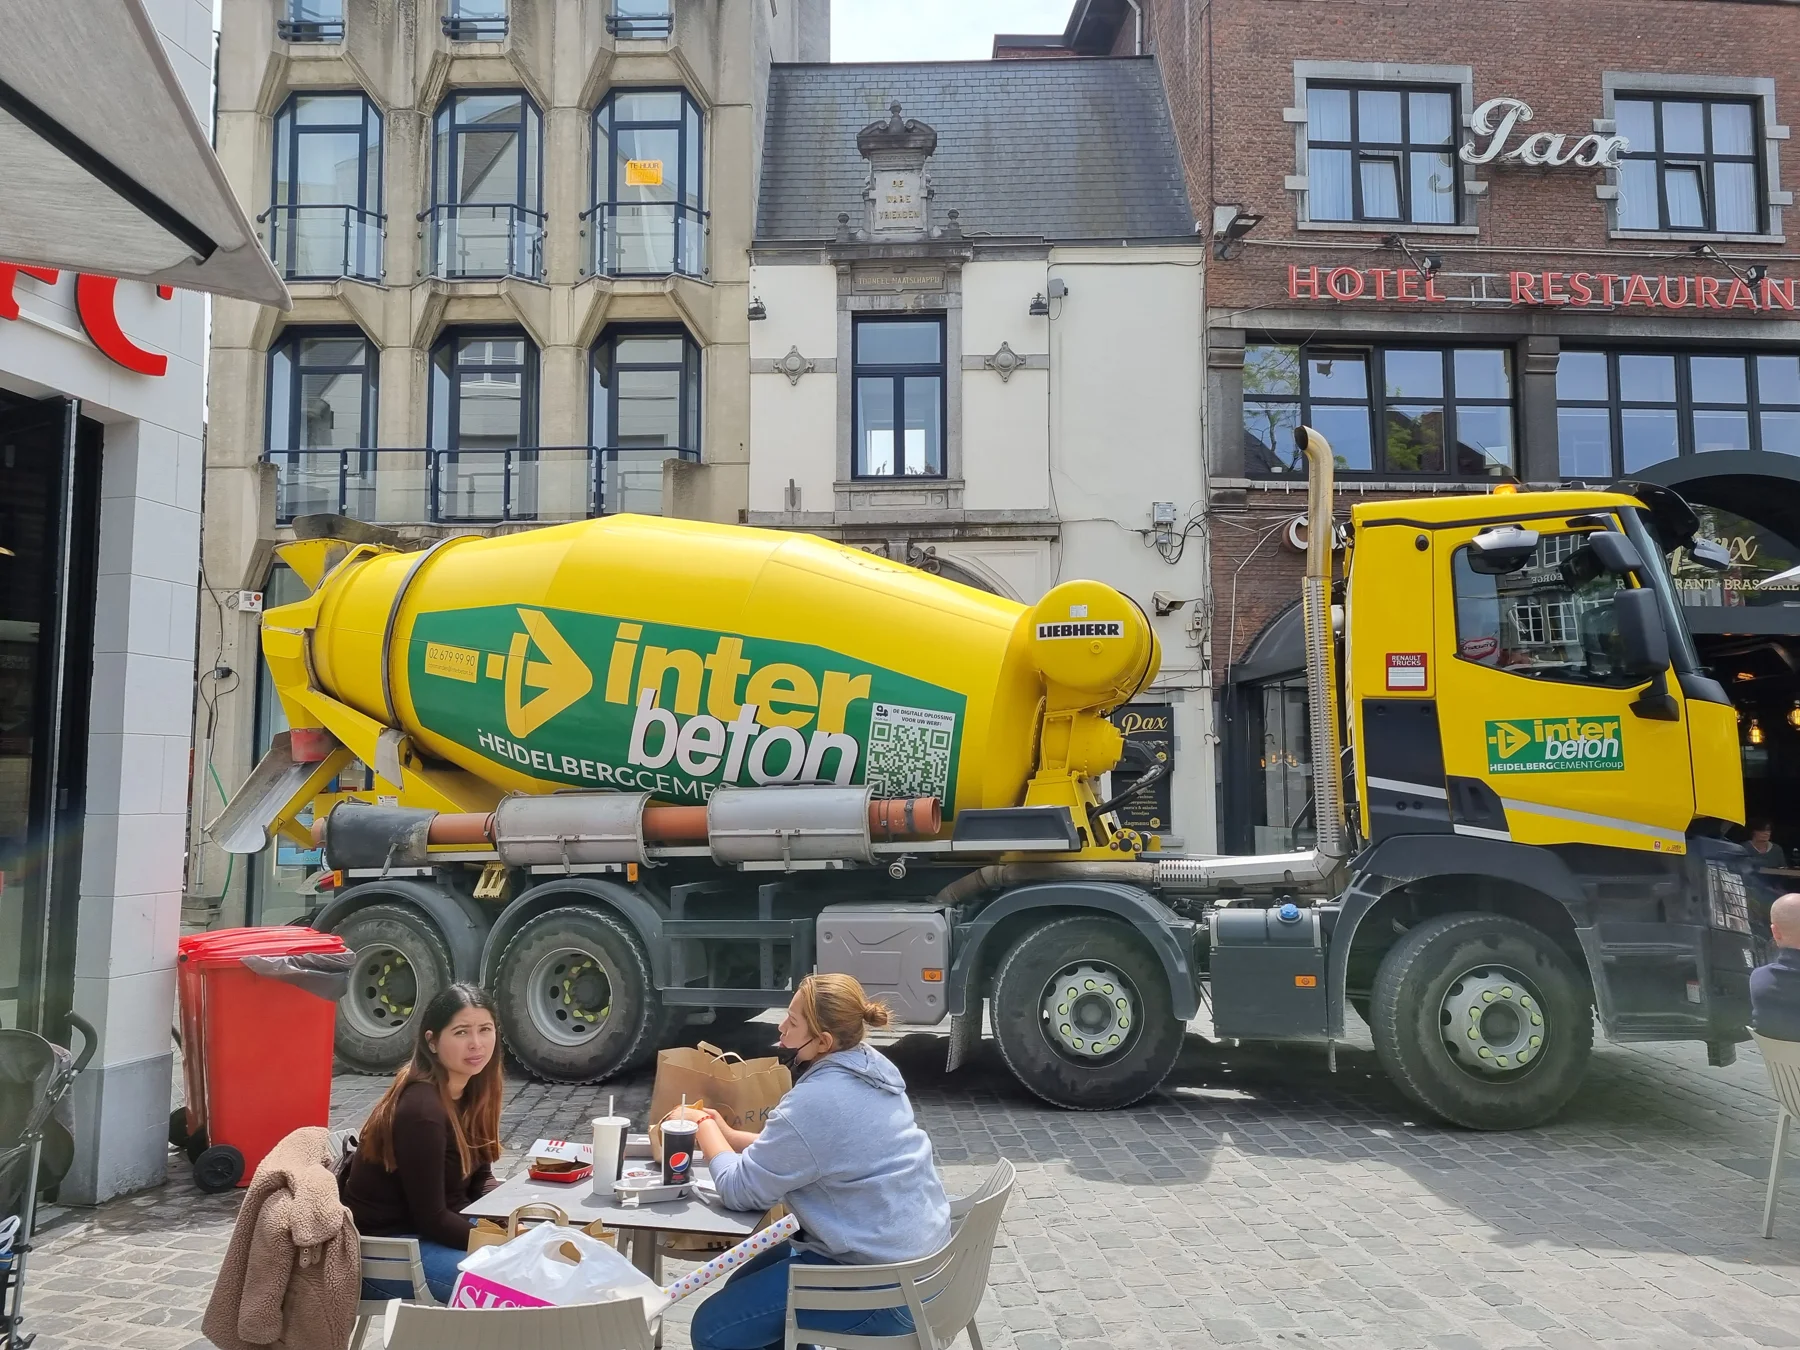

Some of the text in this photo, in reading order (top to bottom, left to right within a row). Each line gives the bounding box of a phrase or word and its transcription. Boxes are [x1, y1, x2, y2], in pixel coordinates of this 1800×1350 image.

[1458, 97, 1632, 166] Pax
[892, 180, 904, 188] DE
[886, 195, 911, 204] WARE
[879, 210, 920, 220] VRIENDEN
[1288, 264, 1800, 311] HOTEL RESTAURAN
[1039, 623, 1120, 638] LIEBHERR
[428, 647, 475, 667] 02 679 99 90
[605, 622, 872, 734] inter
[901, 709, 923, 718] DIGITALE
[924, 713, 953, 722] OPLOSSING
[1121, 712, 1168, 736] Pax
[628, 687, 859, 786] beton
[1533, 718, 1618, 742] inter
[1545, 734, 1619, 760] beton
[477, 728, 716, 801] HEIDELBERGCEME
[1490, 761, 1624, 772] HEIDELBERGCEMENTGroup
[544, 1146, 562, 1154] KFC
